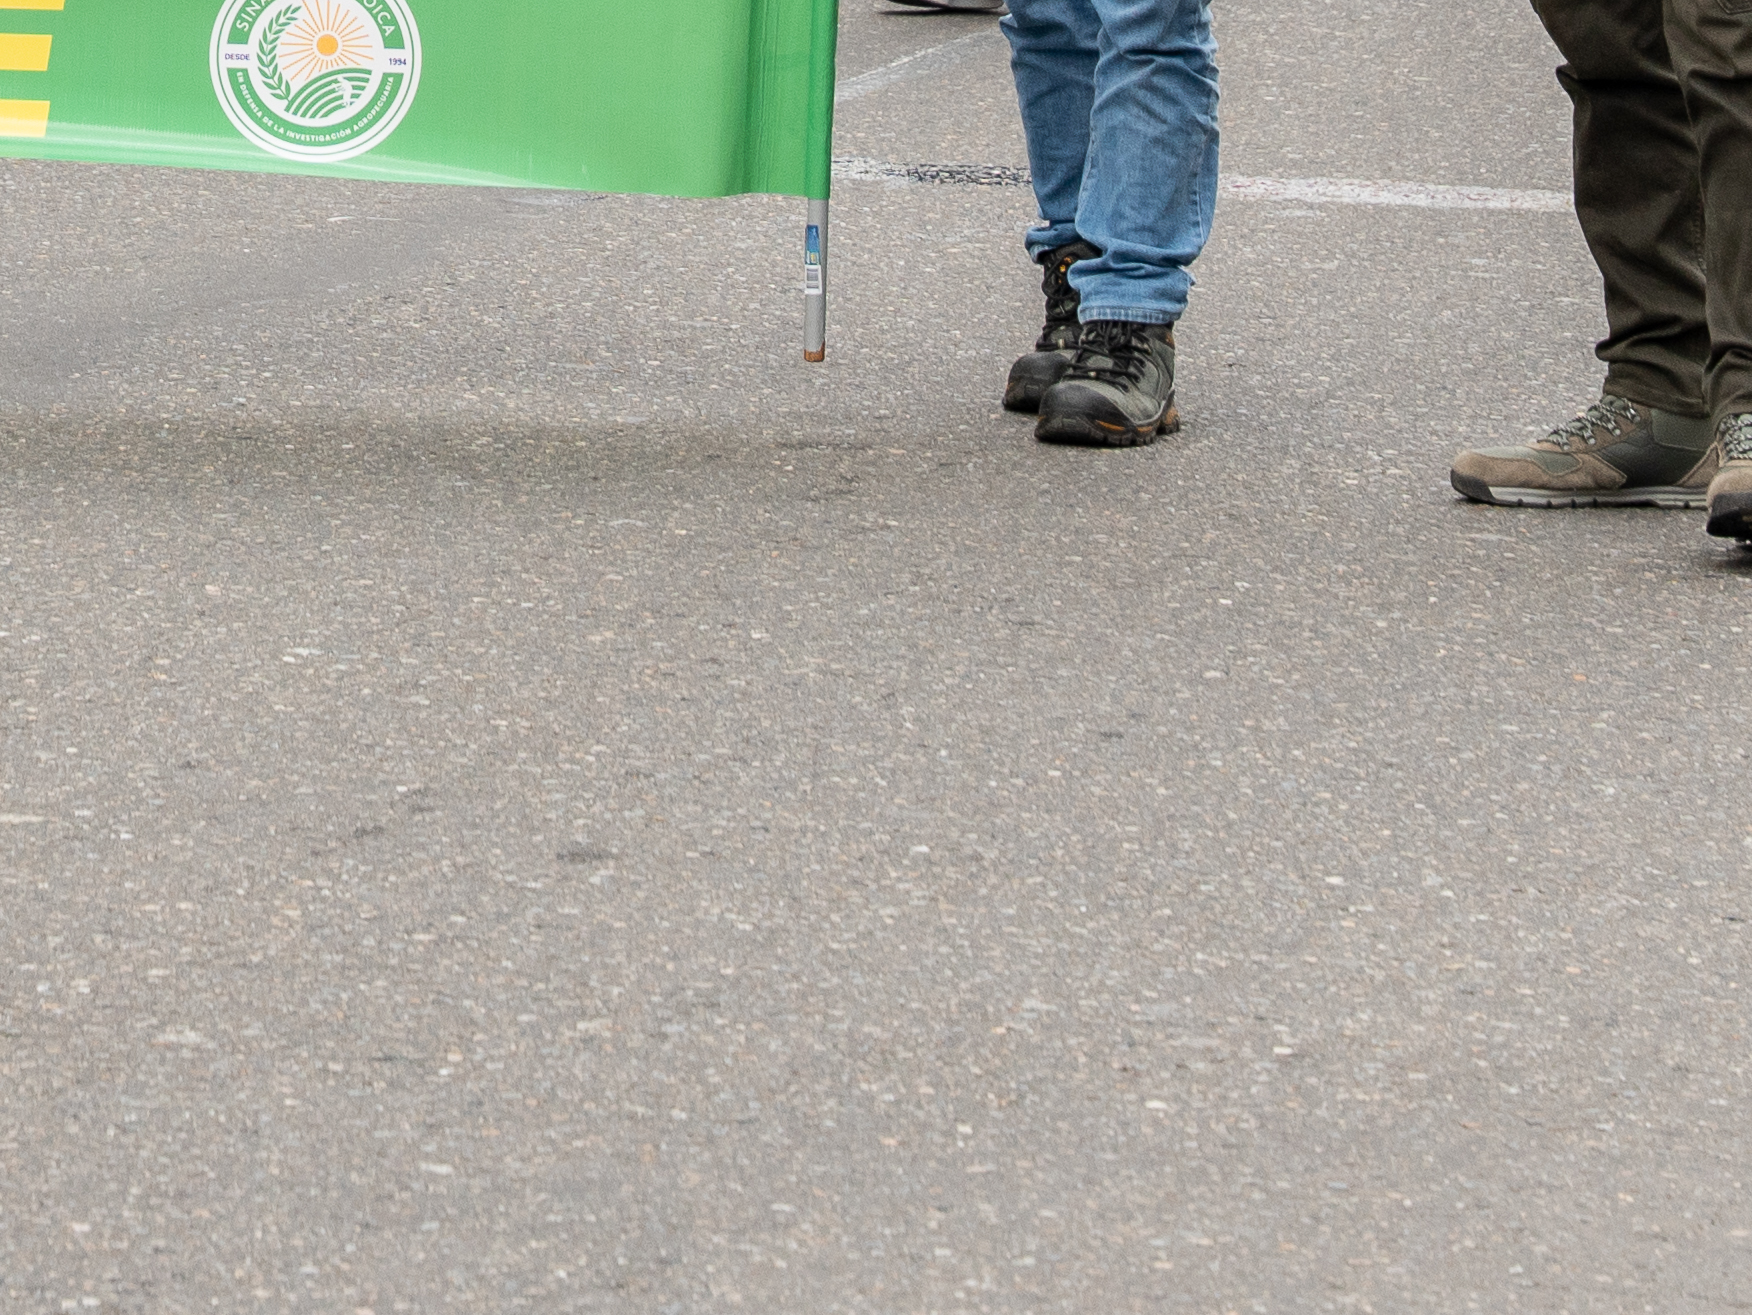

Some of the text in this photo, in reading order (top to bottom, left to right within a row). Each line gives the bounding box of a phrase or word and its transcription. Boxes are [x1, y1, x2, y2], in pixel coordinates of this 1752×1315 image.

[224, 52, 251, 61] DESDE
[238, 82, 262, 119] DEFENSA
[261, 116, 274, 128] DE
[272, 123, 285, 134] LA
[285, 128, 353, 142] INVESTIGACIÓN
[352, 75, 395, 132] AGROPECUARIA
